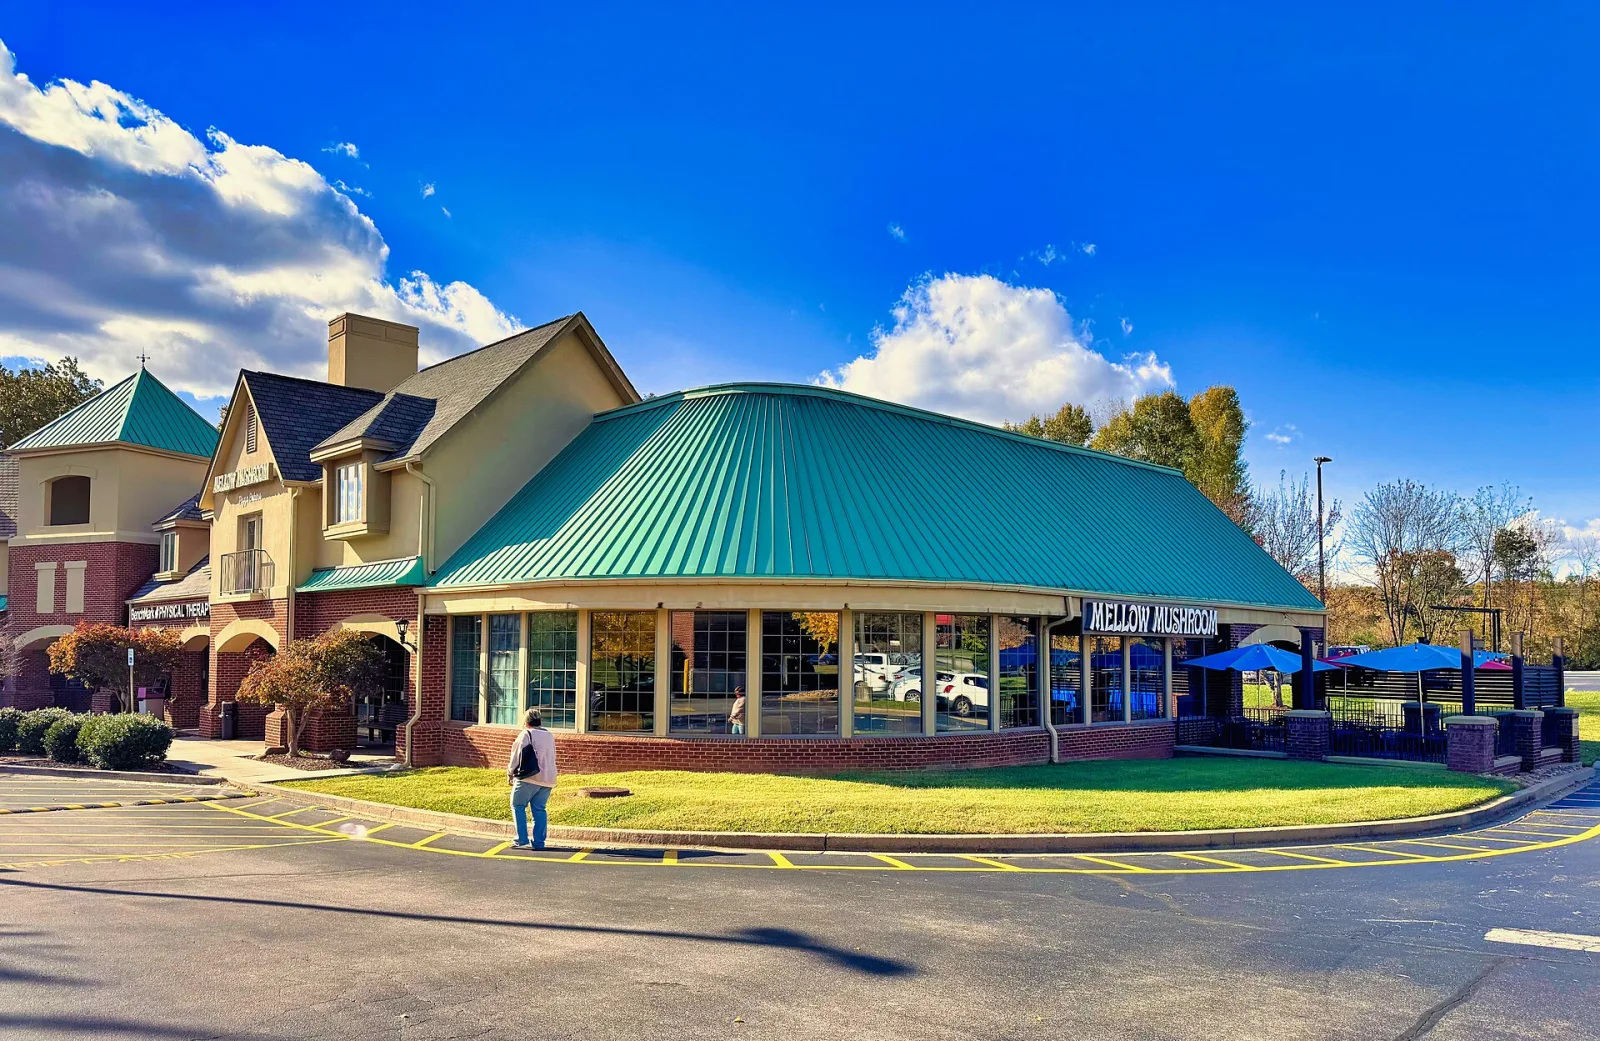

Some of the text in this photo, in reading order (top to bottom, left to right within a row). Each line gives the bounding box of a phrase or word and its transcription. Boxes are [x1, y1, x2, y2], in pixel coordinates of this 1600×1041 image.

[131, 602, 209, 620] BenchMark PHYSICAL THERAP
[1089, 602, 1219, 636] MELLOW MUSHROOM
